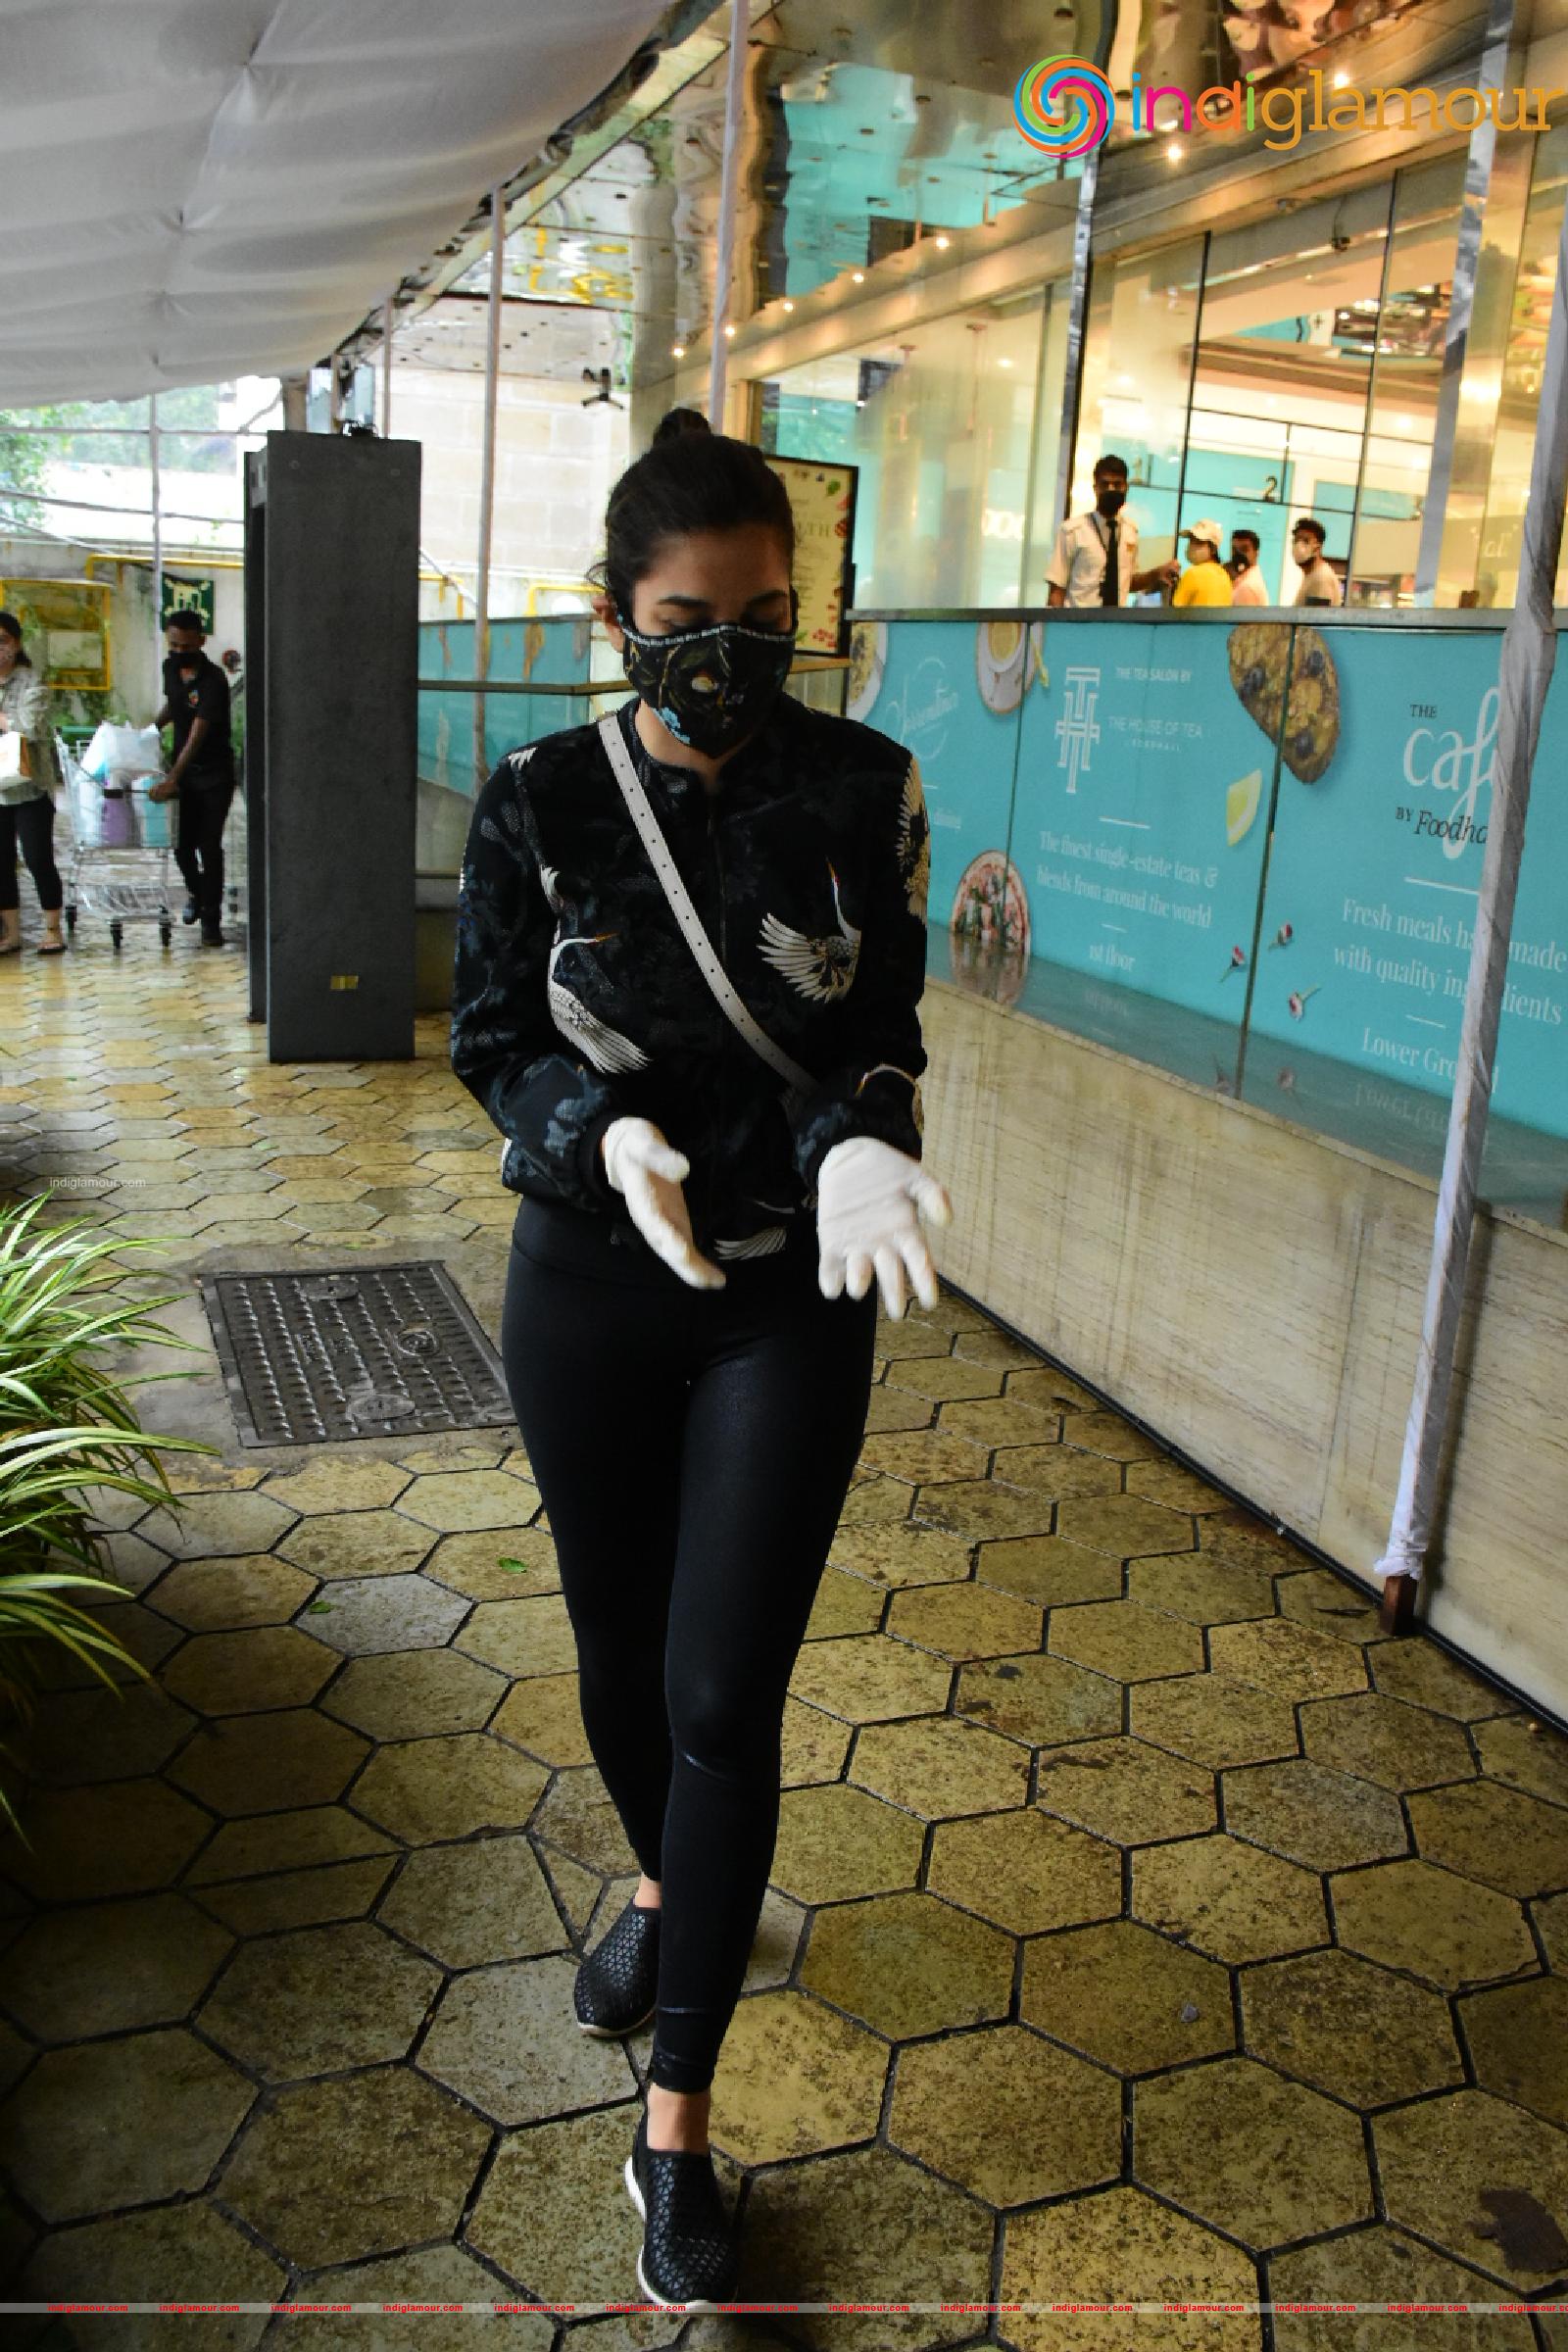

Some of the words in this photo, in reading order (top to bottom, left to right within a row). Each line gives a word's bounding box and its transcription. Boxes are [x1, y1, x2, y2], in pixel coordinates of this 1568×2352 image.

[1410, 704, 1438, 718] THE
[1040, 830, 1058, 854] The
[1396, 807, 1414, 821] BY
[1414, 809, 1489, 844] Foodha
[1074, 874, 1102, 900] from
[1102, 886, 1148, 911] around
[1149, 892, 1170, 918] the
[1171, 901, 1211, 928] world
[1343, 898, 1392, 931] Fresh
[1397, 915, 1450, 945] meals
[1334, 944, 1372, 973] with
[1376, 958, 1438, 996] quality
[1362, 1027, 1420, 1067] Lower
